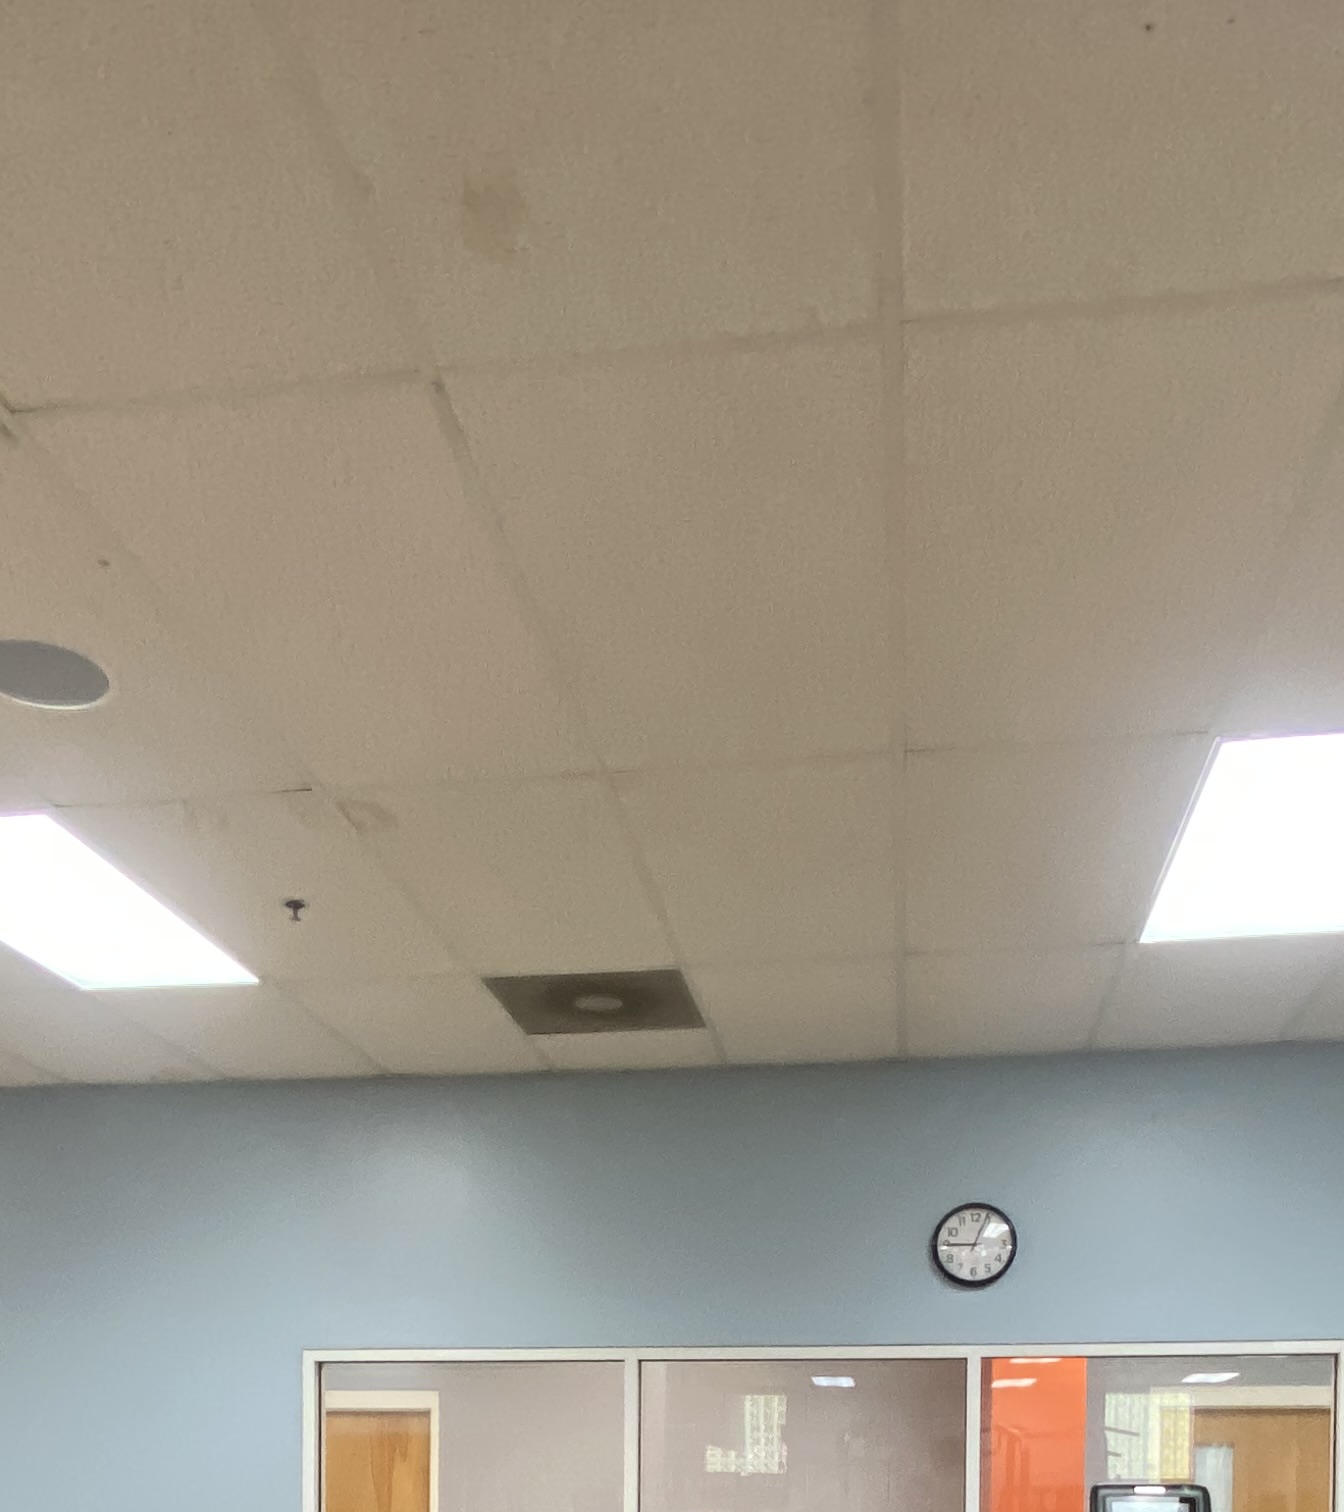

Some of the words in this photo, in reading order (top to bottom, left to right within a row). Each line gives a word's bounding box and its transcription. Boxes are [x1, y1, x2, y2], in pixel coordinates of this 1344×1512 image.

[958, 1216, 966, 1226] 11
[970, 1212, 981, 1222] 12
[947, 1227, 958, 1237] 10
[946, 1254, 954, 1263] 8
[994, 1253, 1002, 1262] 4
[970, 1267, 977, 1276] 6
[984, 1263, 991, 1273] 5
